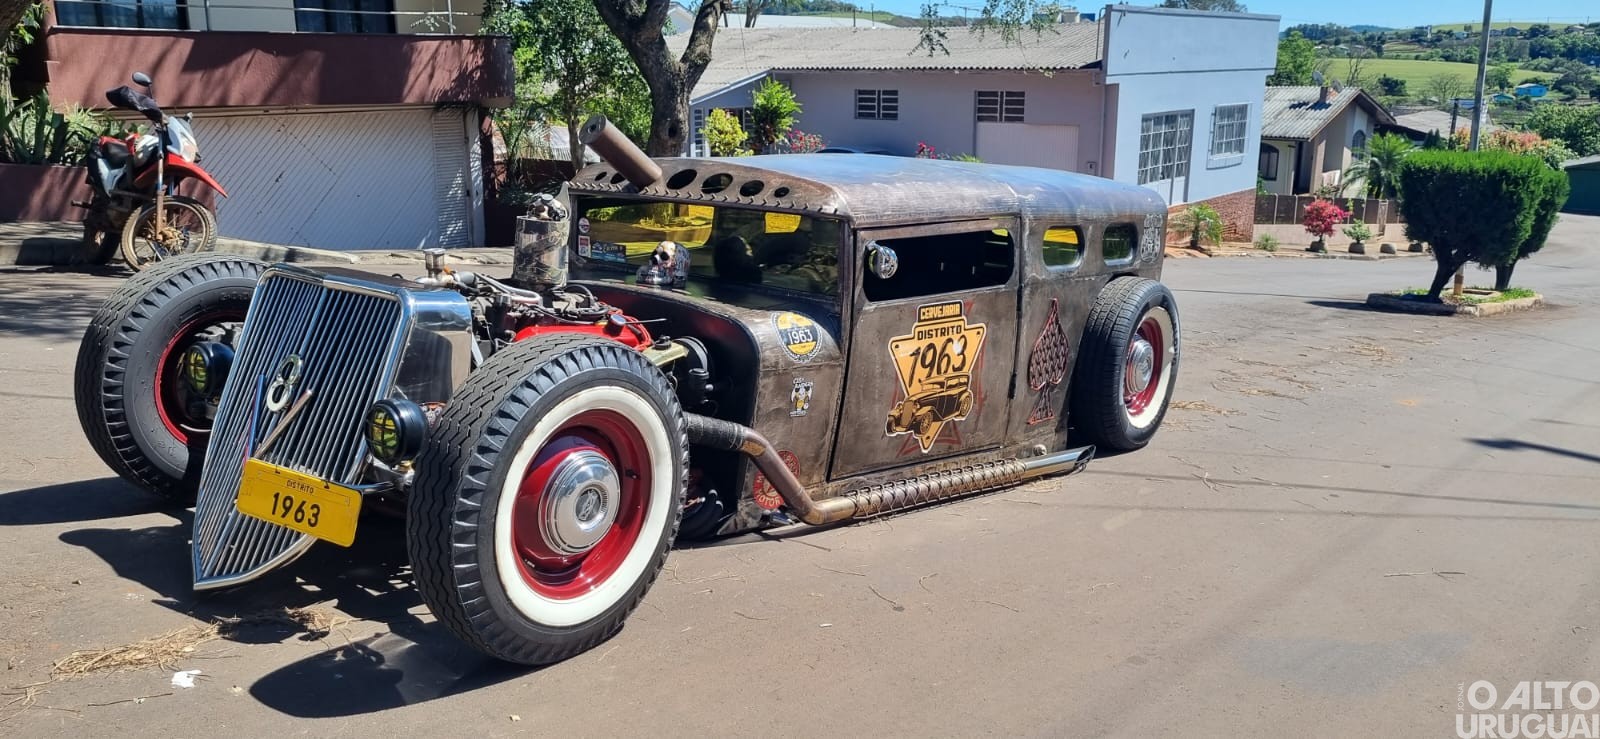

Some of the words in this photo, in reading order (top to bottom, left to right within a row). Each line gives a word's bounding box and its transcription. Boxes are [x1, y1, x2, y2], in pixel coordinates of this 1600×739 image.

[920, 304, 961, 320] CERVEJARIA
[787, 329, 813, 345] 1963
[917, 325, 962, 341] DISTRITO
[908, 335, 968, 389] 1963
[286, 480, 314, 494] DISTRITO
[272, 492, 321, 528] 1963
